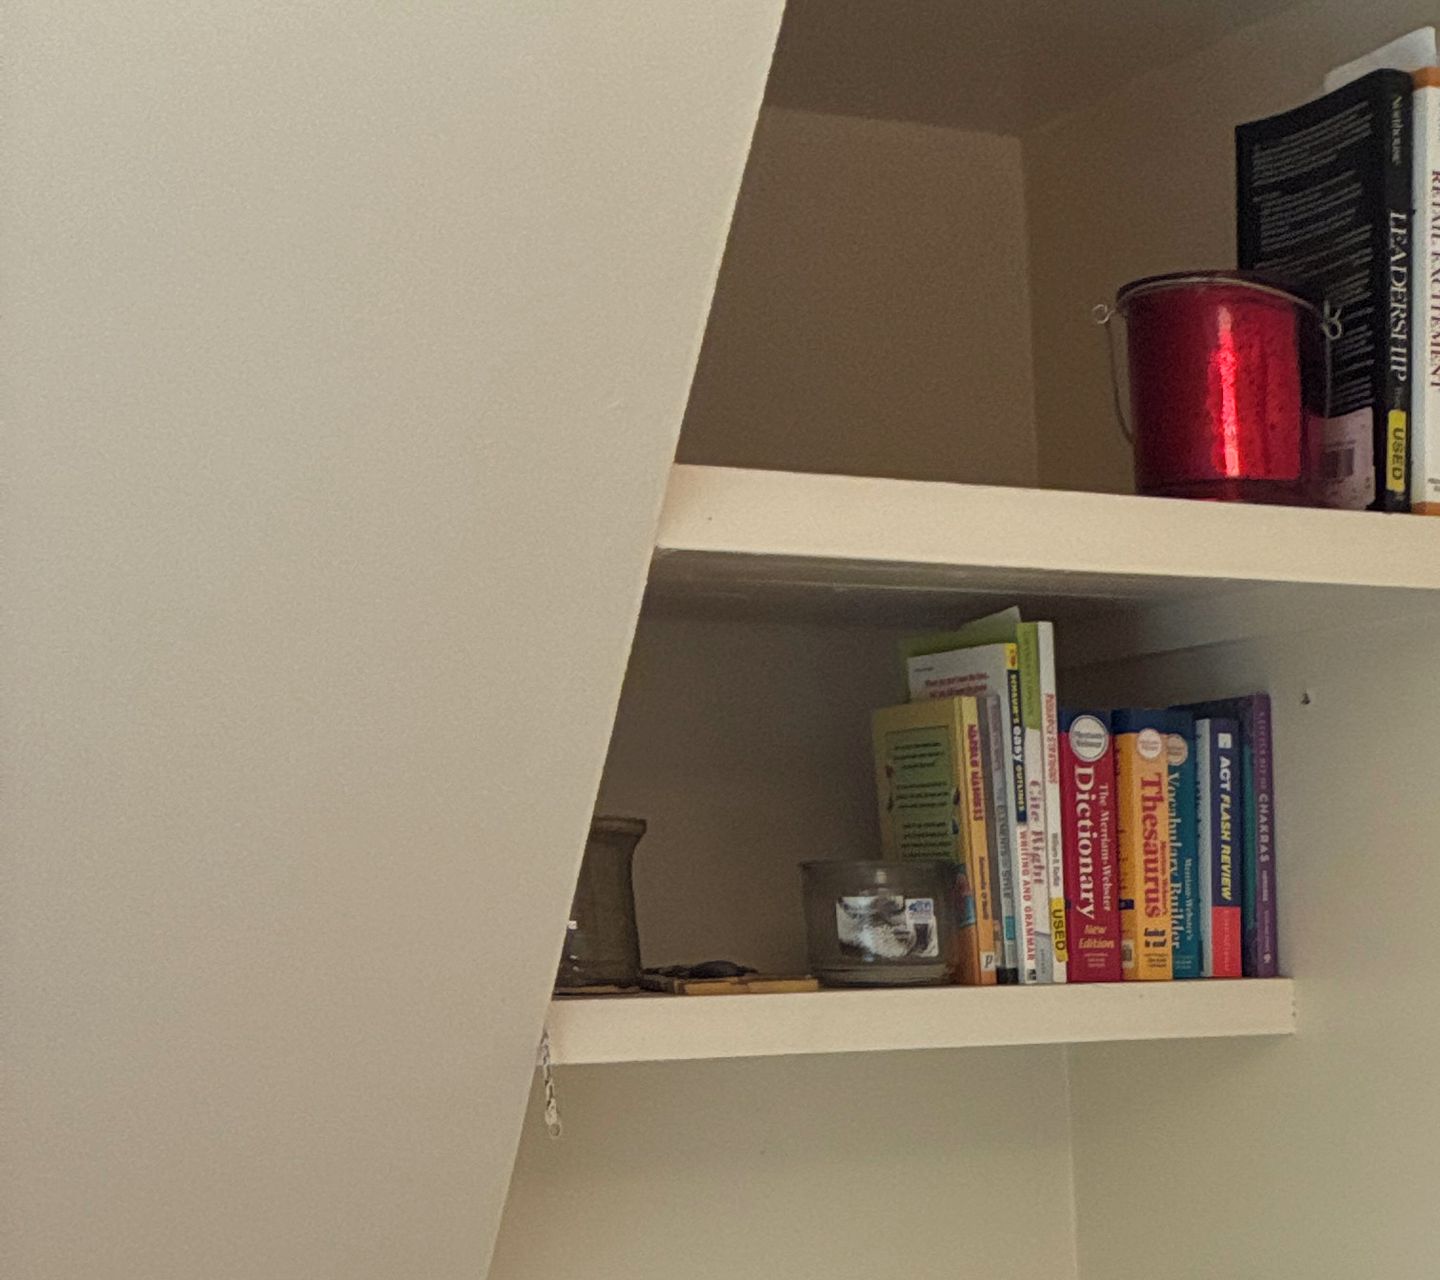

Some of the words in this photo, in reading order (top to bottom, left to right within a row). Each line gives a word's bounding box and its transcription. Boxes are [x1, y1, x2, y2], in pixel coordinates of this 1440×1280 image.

[1387, 210, 1408, 383] LEADERSHIP
[1391, 427, 1402, 480] USED
[1099, 782, 1110, 806] The
[1218, 756, 1231, 792] ACT
[1028, 780, 1044, 822] Cite
[1219, 793, 1232, 843] FLASH
[1258, 793, 1270, 862] CHAKRAS
[1017, 831, 1033, 876] WRITING
[1028, 830, 1046, 884] Right
[1074, 763, 1095, 920] Dictionary
[1098, 809, 1111, 912] Merriam-Webster
[1140, 773, 1163, 919] Thesaurus
[1022, 880, 1034, 903] AND
[1221, 844, 1232, 901] REVIEW
[1024, 906, 1037, 962] GRAMMAR
[1053, 909, 1067, 953] USED
[1078, 937, 1114, 949] Edition
[1084, 924, 1107, 935] New
[1169, 883, 1183, 950] Builder
